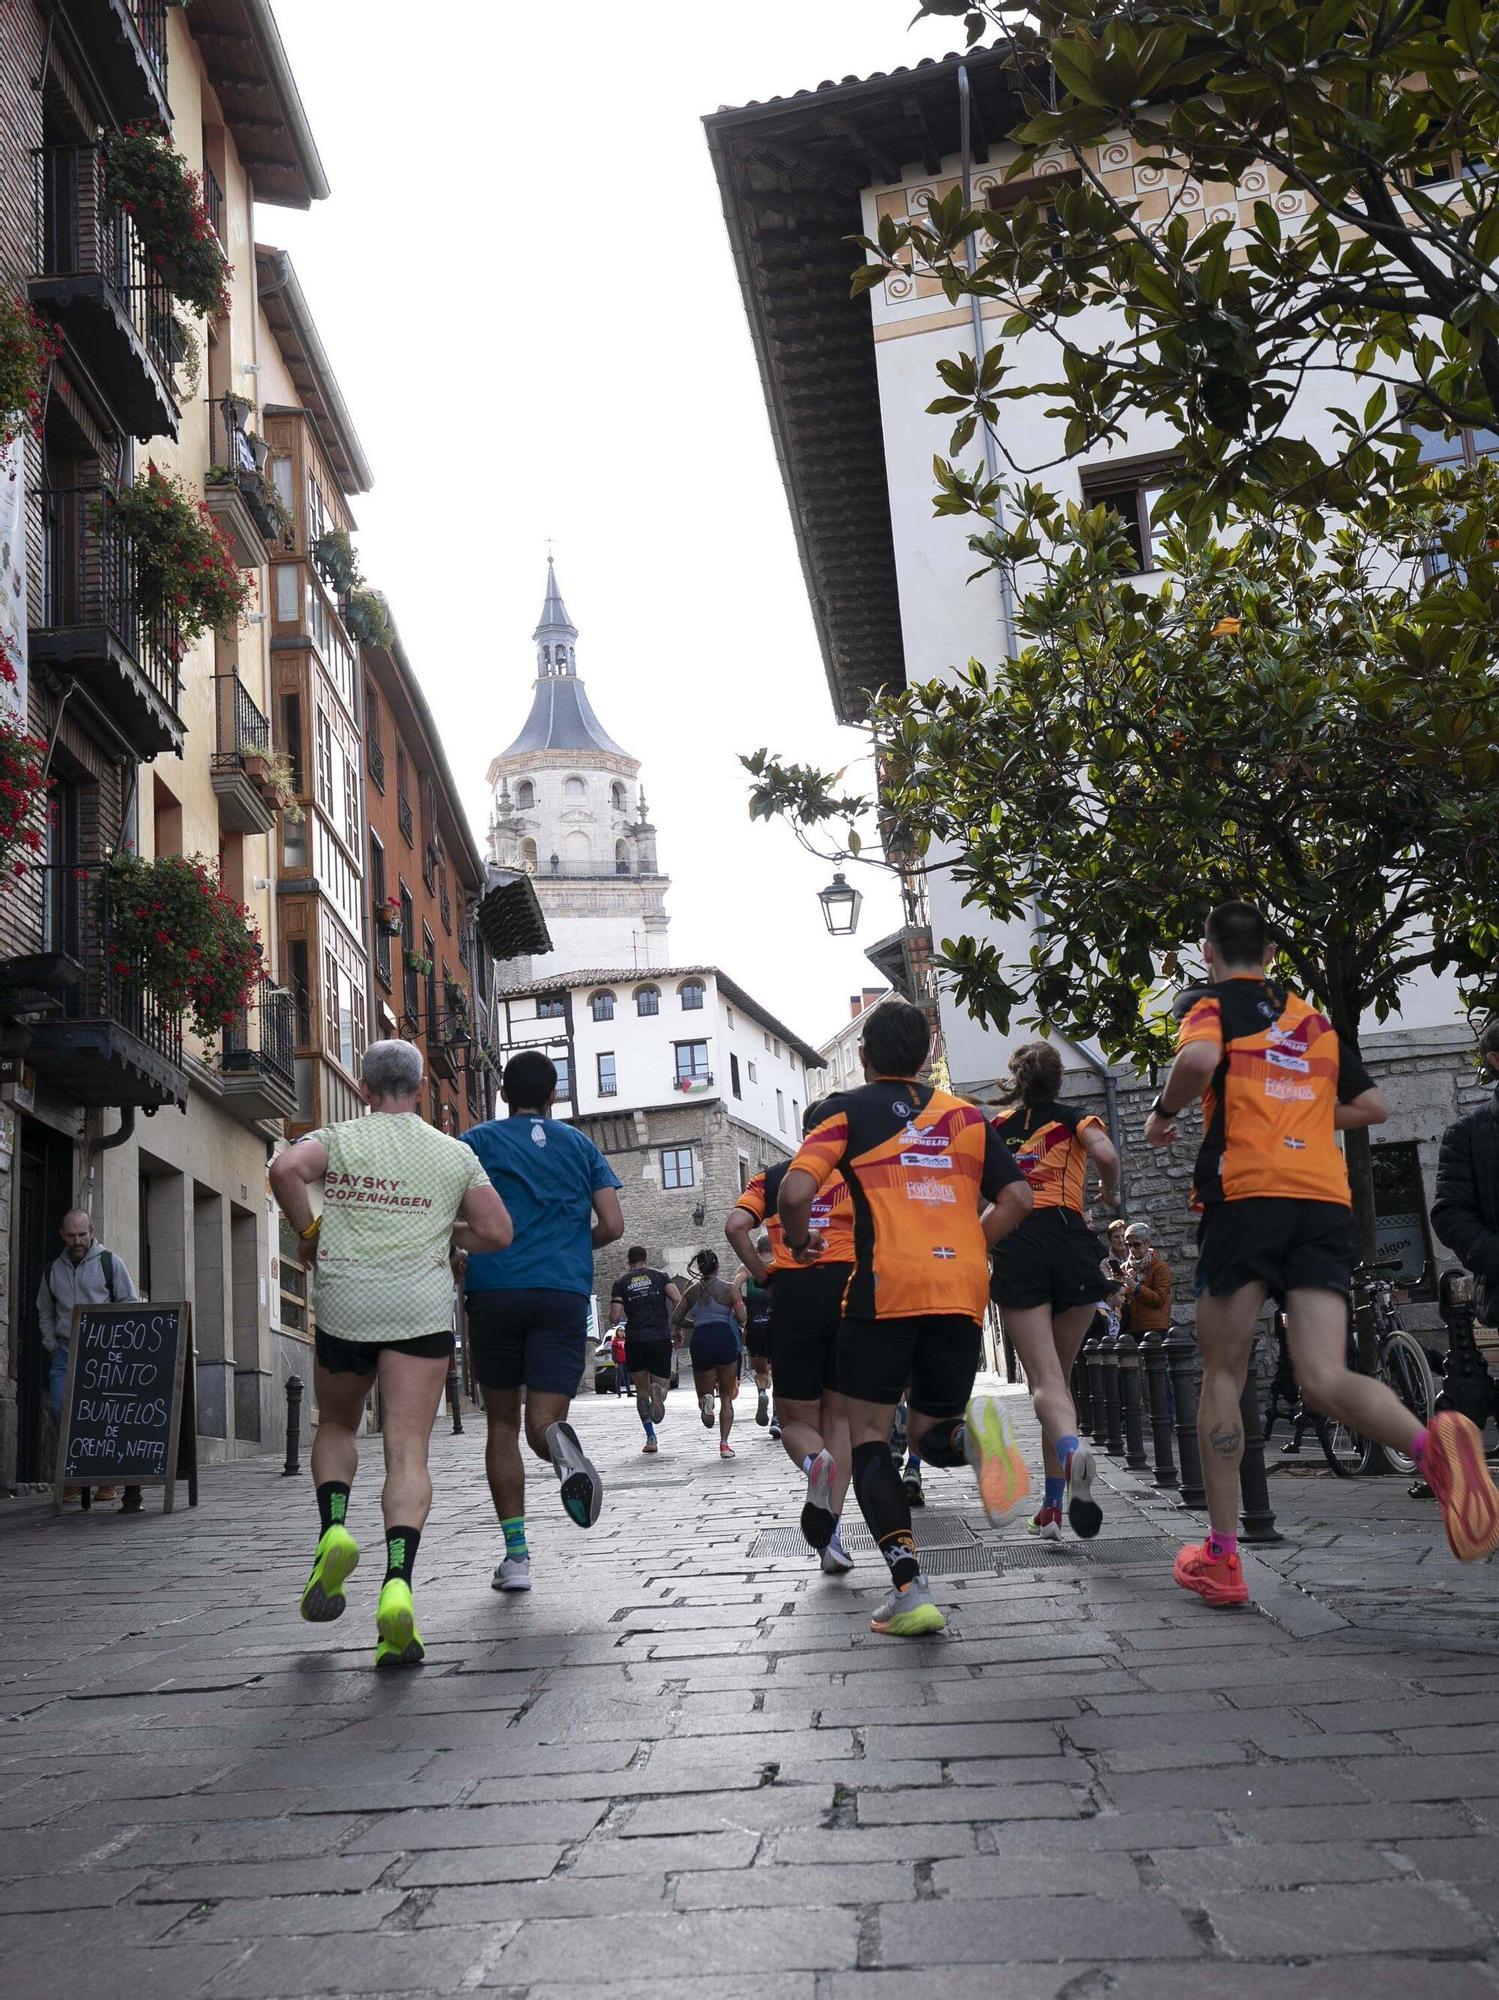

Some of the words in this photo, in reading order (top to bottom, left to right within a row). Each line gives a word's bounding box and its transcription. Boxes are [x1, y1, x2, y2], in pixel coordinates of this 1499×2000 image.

[898, 1137, 950, 1147] MICHELIN
[324, 1188, 432, 1209] COPENHAGEN
[86, 1317, 163, 1352] HUESOS
[109, 1352, 123, 1362] DE
[83, 1359, 158, 1390] SANTO
[77, 1399, 167, 1427] BUÑUELOS
[105, 1425, 119, 1438] DE
[70, 1437, 116, 1458] CREMA
[127, 1440, 165, 1460] NATA
